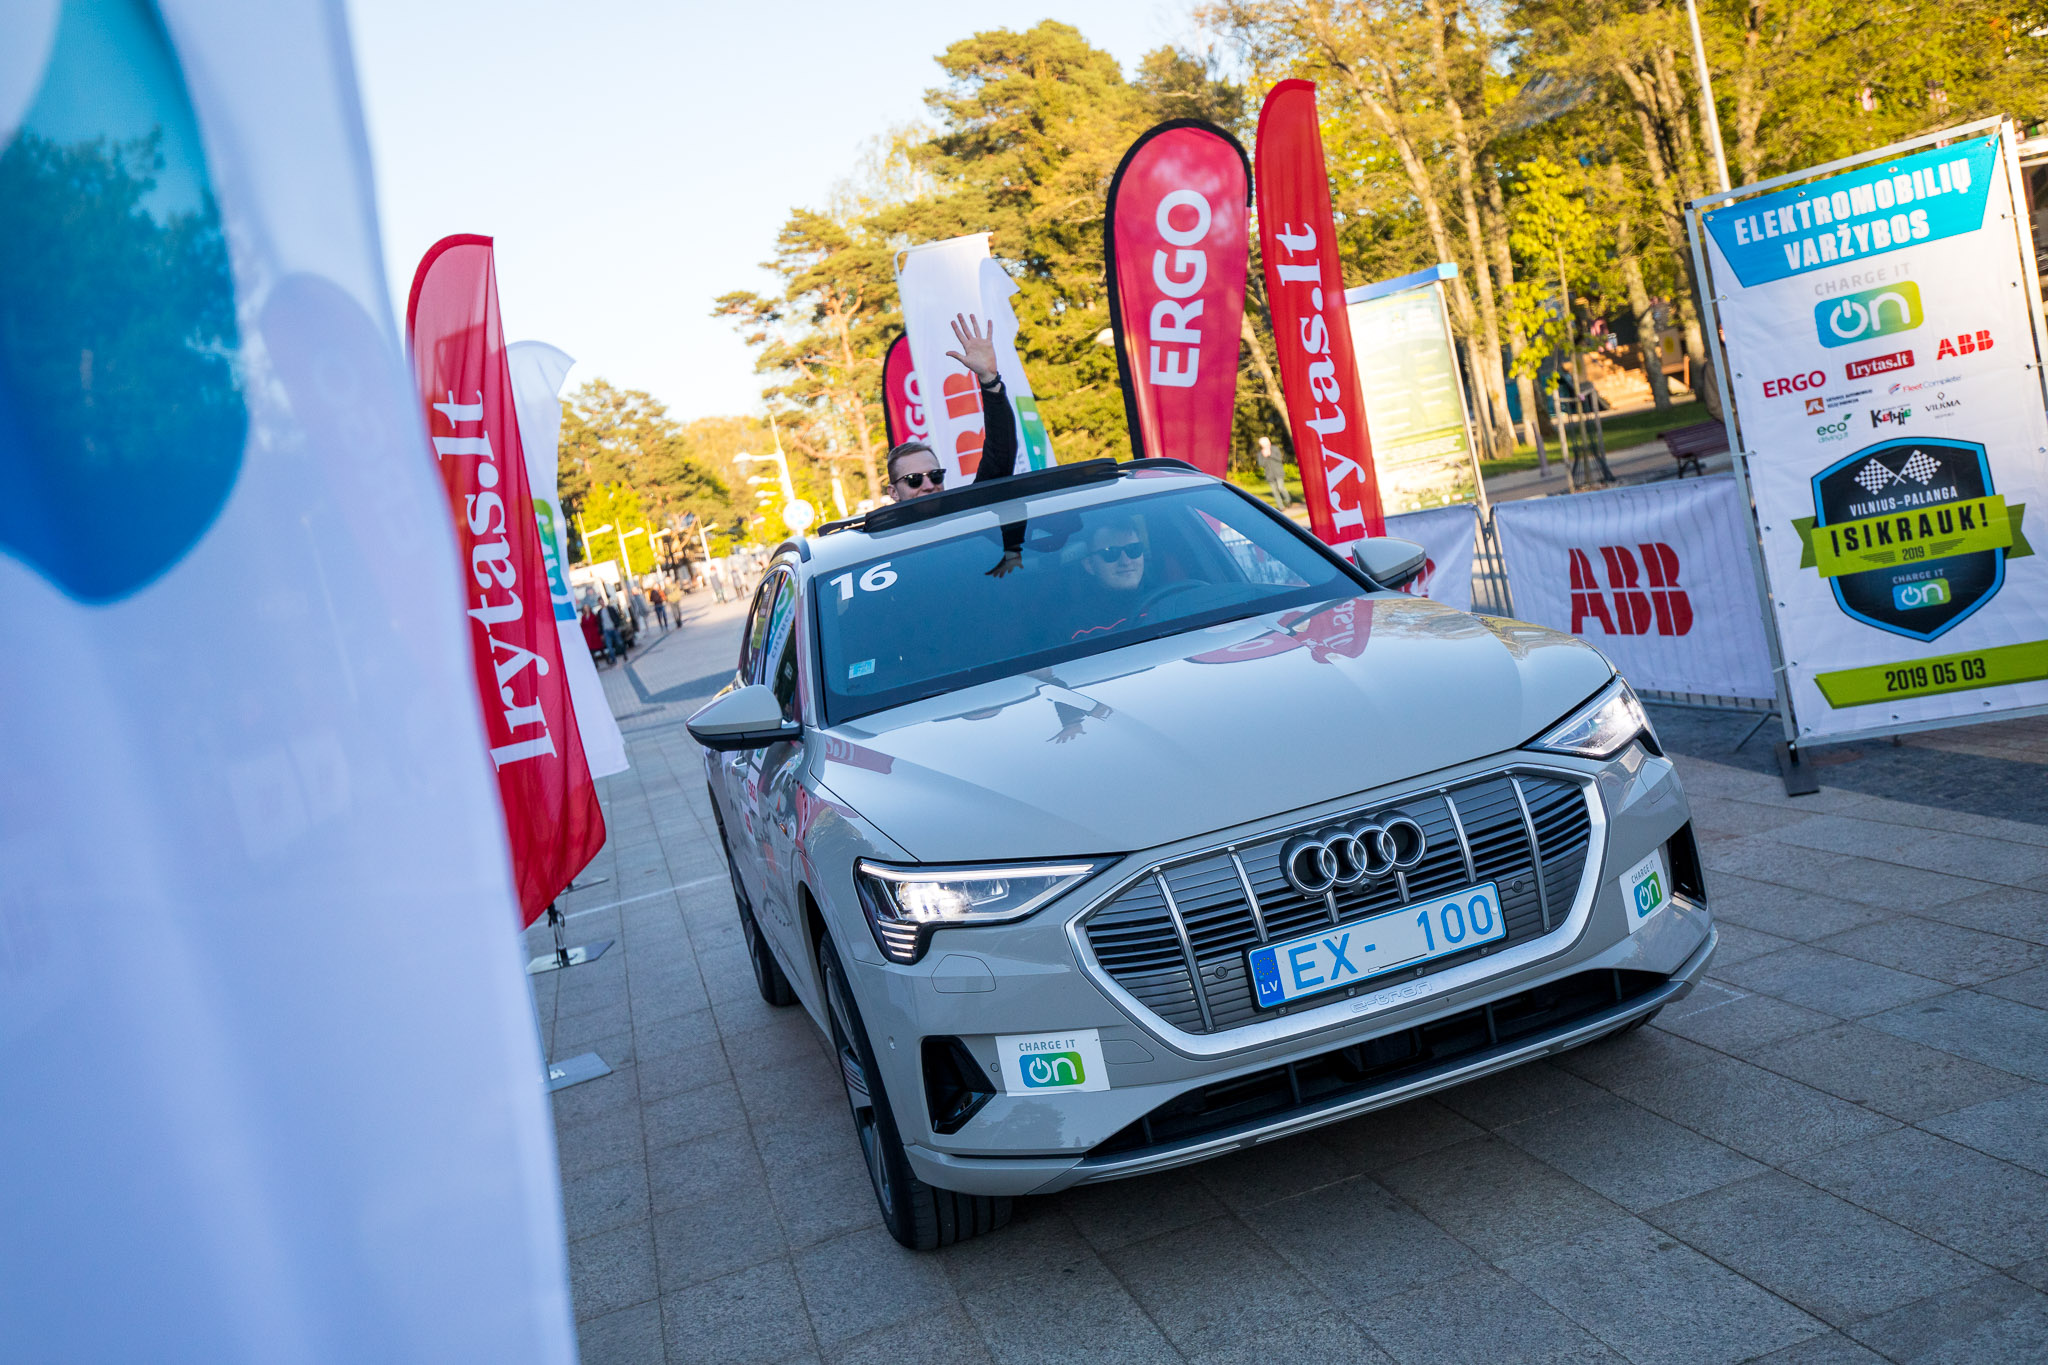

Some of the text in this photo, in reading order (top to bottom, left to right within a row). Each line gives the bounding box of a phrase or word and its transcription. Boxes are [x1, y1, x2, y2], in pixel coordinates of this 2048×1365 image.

[1734, 158, 1972, 245] ELEKTROMOBILIŲ
[1783, 209, 1930, 270] VARŽYBOS
[1149, 189, 1212, 388] ERGO
[1814, 262, 1912, 297] CHARGE IT
[1937, 329, 1995, 361] ABB
[1762, 369, 1827, 399] ERGO
[1816, 422, 1847, 437] eco
[1830, 502, 1989, 558] ĮSIKRAUK!
[1902, 545, 1925, 561] 2019
[830, 561, 898, 601] 16
[1569, 542, 1694, 637] ABB
[1892, 568, 1945, 585] CHARGE IT
[1885, 658, 1987, 693] 2019 05 03
[1631, 859, 1655, 884] CHARGE IT
[1417, 894, 1493, 951] 100
[1261, 979, 1279, 995] LV
[1351, 981, 1432, 1014] e-tron
[1019, 1039, 1075, 1052] CHARGE IT
